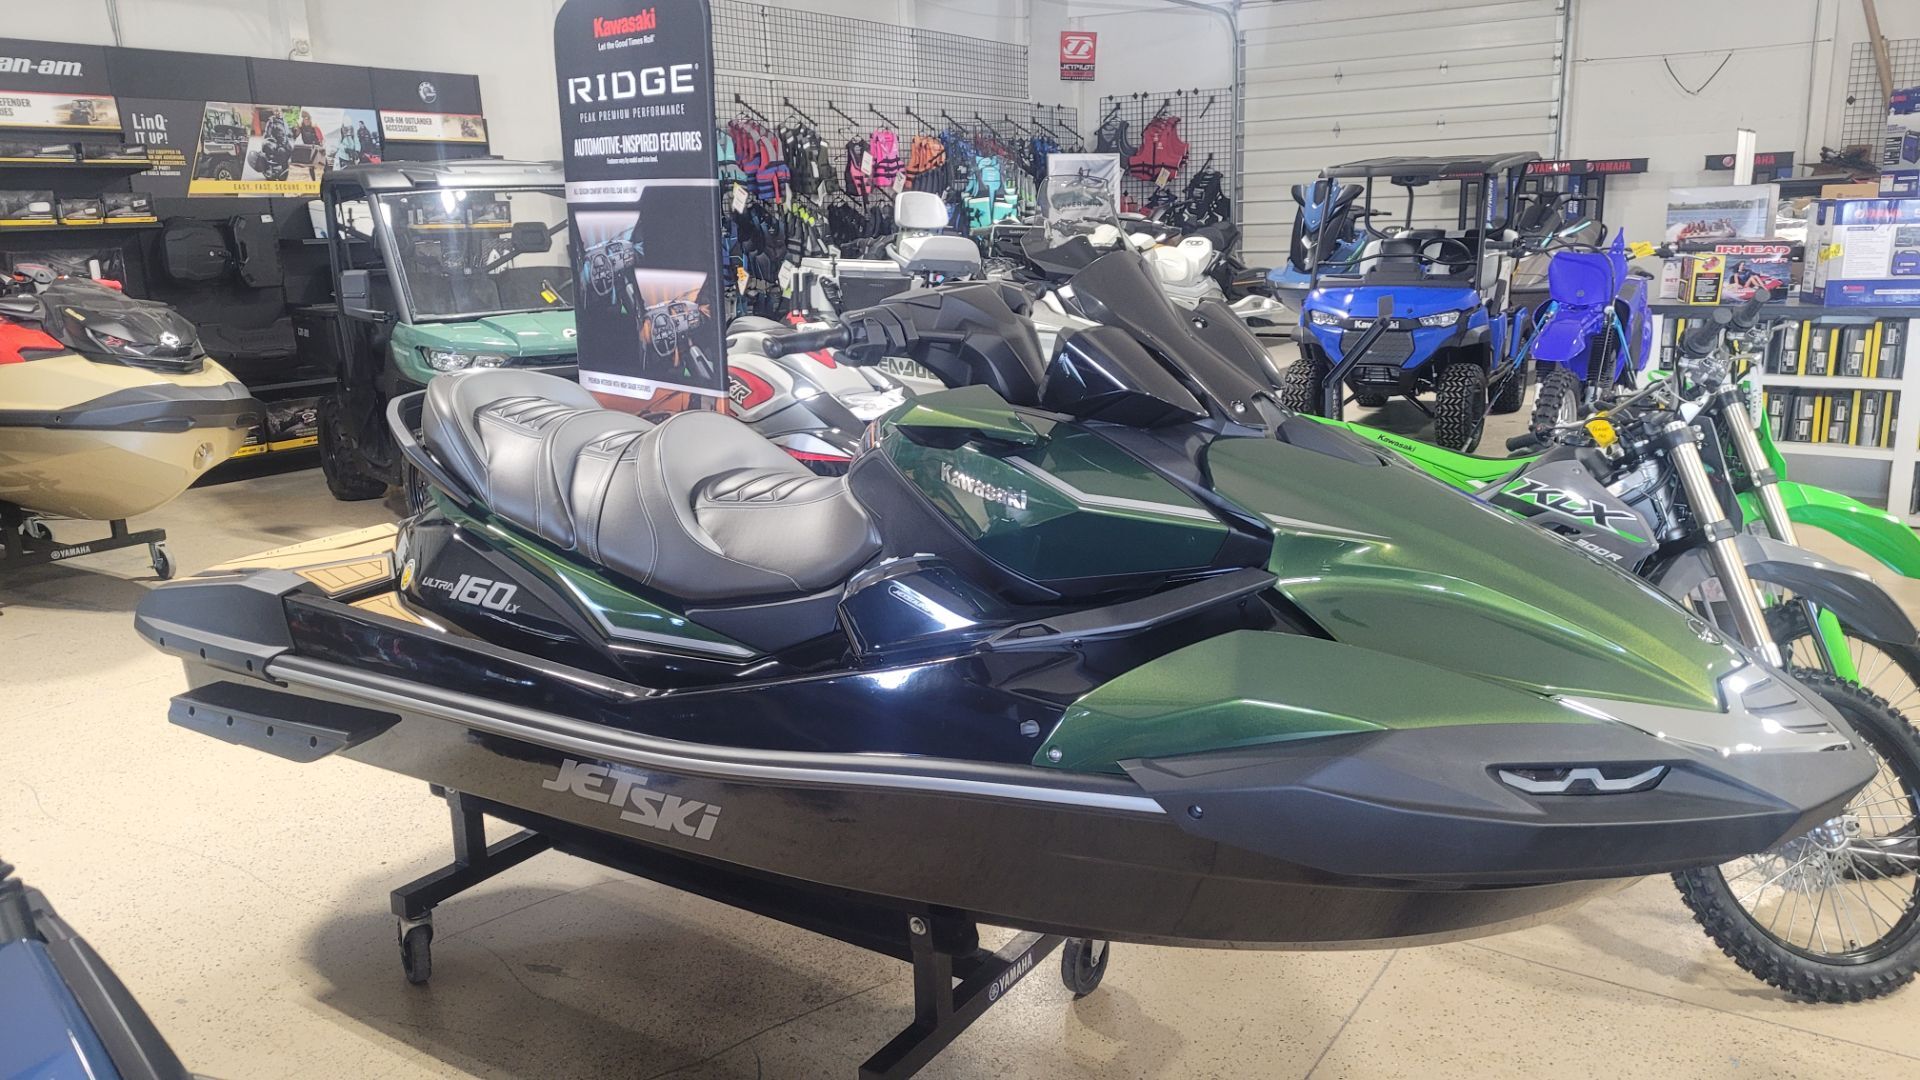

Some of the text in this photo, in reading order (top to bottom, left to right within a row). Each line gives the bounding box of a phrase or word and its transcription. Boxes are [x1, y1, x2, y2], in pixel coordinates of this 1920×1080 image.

[594, 7, 656, 38] Kawasaki
[615, 39, 628, 49] Good
[628, 37, 643, 46] Times
[568, 64, 695, 104] RIDGE
[132, 113, 166, 130] LinQ
[384, 116, 432, 126] CAN-AM OUTLANDER
[580, 103, 685, 123] PEAK PREMIUM PERFORMANCE
[386, 124, 418, 132] ACCESSORIES
[135, 132, 168, 144] IT UP!
[574, 131, 702, 156] AUTOMOTIVE-INSPIRED FEATURES
[1534, 162, 1571, 173] YAMHA
[1595, 161, 1631, 172] YAMAHA
[1714, 244, 1791, 254] IRHEAD
[1354, 320, 1400, 329] Kawki
[1377, 433, 1416, 452] Kawasaki
[941, 462, 1028, 510] Kawasaki
[1505, 477, 1637, 535] KLX
[60, 545, 91, 558] YAMAHA
[422, 574, 520, 614] ULTRA 160 LX
[999, 952, 1032, 992] YAMAHA
